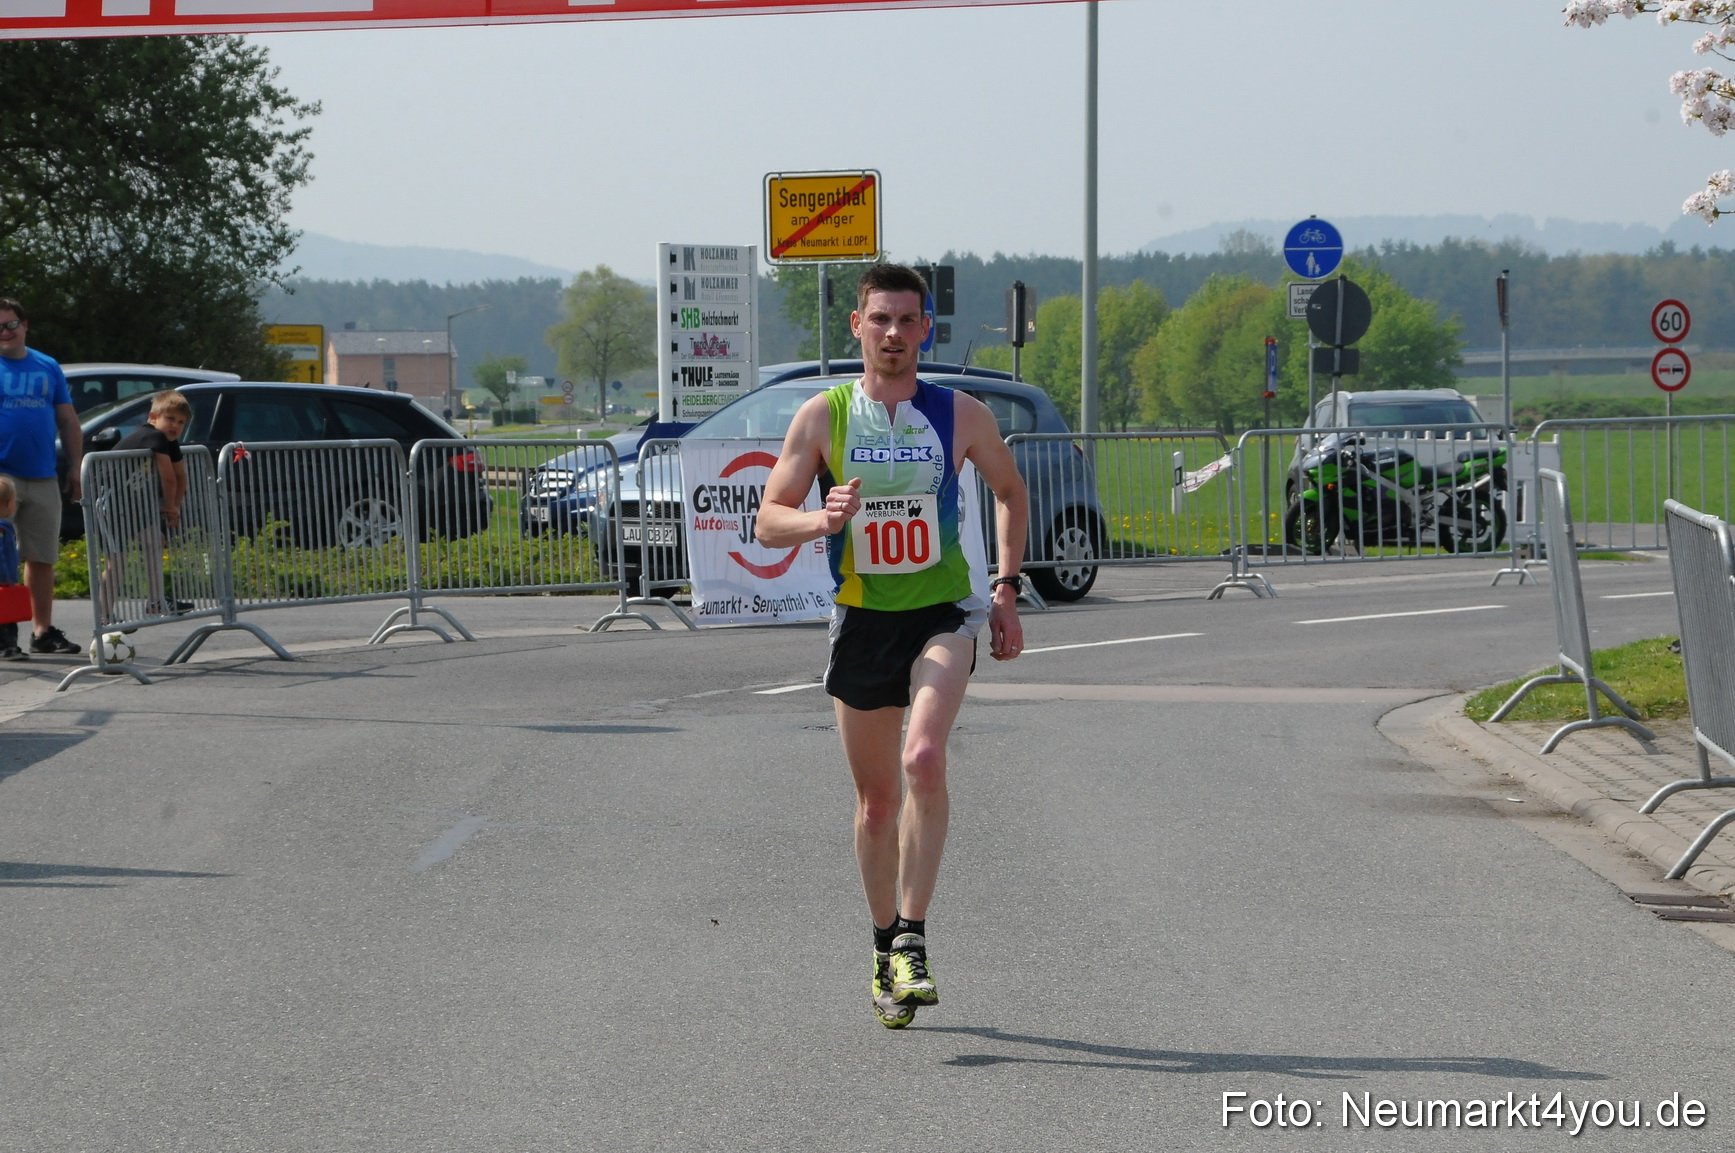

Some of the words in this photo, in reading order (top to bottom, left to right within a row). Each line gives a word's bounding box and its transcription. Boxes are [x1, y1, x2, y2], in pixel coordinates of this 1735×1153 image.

[779, 186, 866, 212] Sengenthal
[791, 215, 810, 226] am
[817, 213, 855, 228] Anger
[777, 237, 797, 248] Kreis
[800, 236, 839, 247] Neumarkt
[700, 247, 738, 261] HOLZAMMER
[700, 277, 738, 290] HOLZAMMER
[680, 307, 700, 330] SHB
[701, 310, 739, 326] Holzfachmarkt
[1660, 311, 1682, 332] 60
[680, 366, 713, 387] THULE
[856, 434, 905, 446] TEAM
[850, 446, 934, 463] BOCK
[865, 500, 905, 511] MEYER
[865, 509, 906, 518] WERBUNG
[864, 519, 930, 565] 100
[752, 592, 805, 617] Sengenthal
